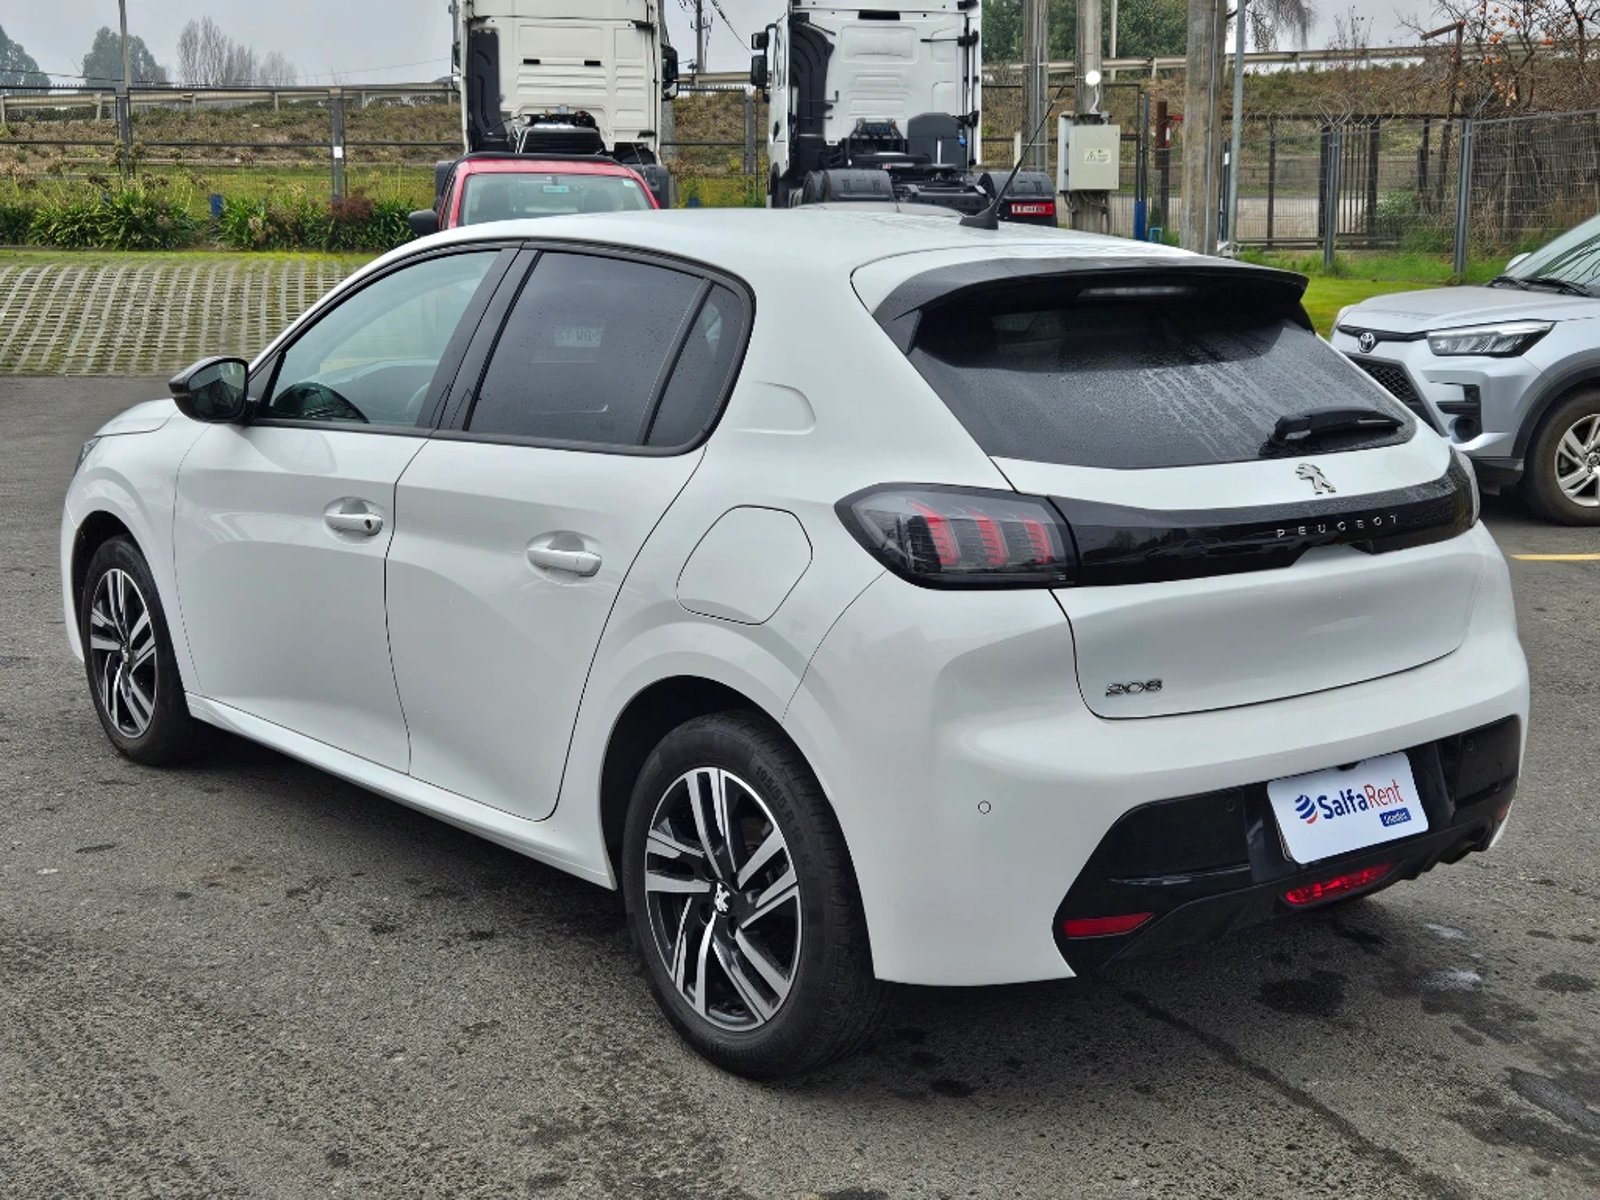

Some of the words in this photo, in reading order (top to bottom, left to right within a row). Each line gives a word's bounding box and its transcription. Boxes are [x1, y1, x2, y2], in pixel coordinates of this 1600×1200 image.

[1275, 514, 1398, 539] PEUGEOT
[1105, 678, 1163, 697] 208
[1316, 778, 1404, 820] SalfaRent
